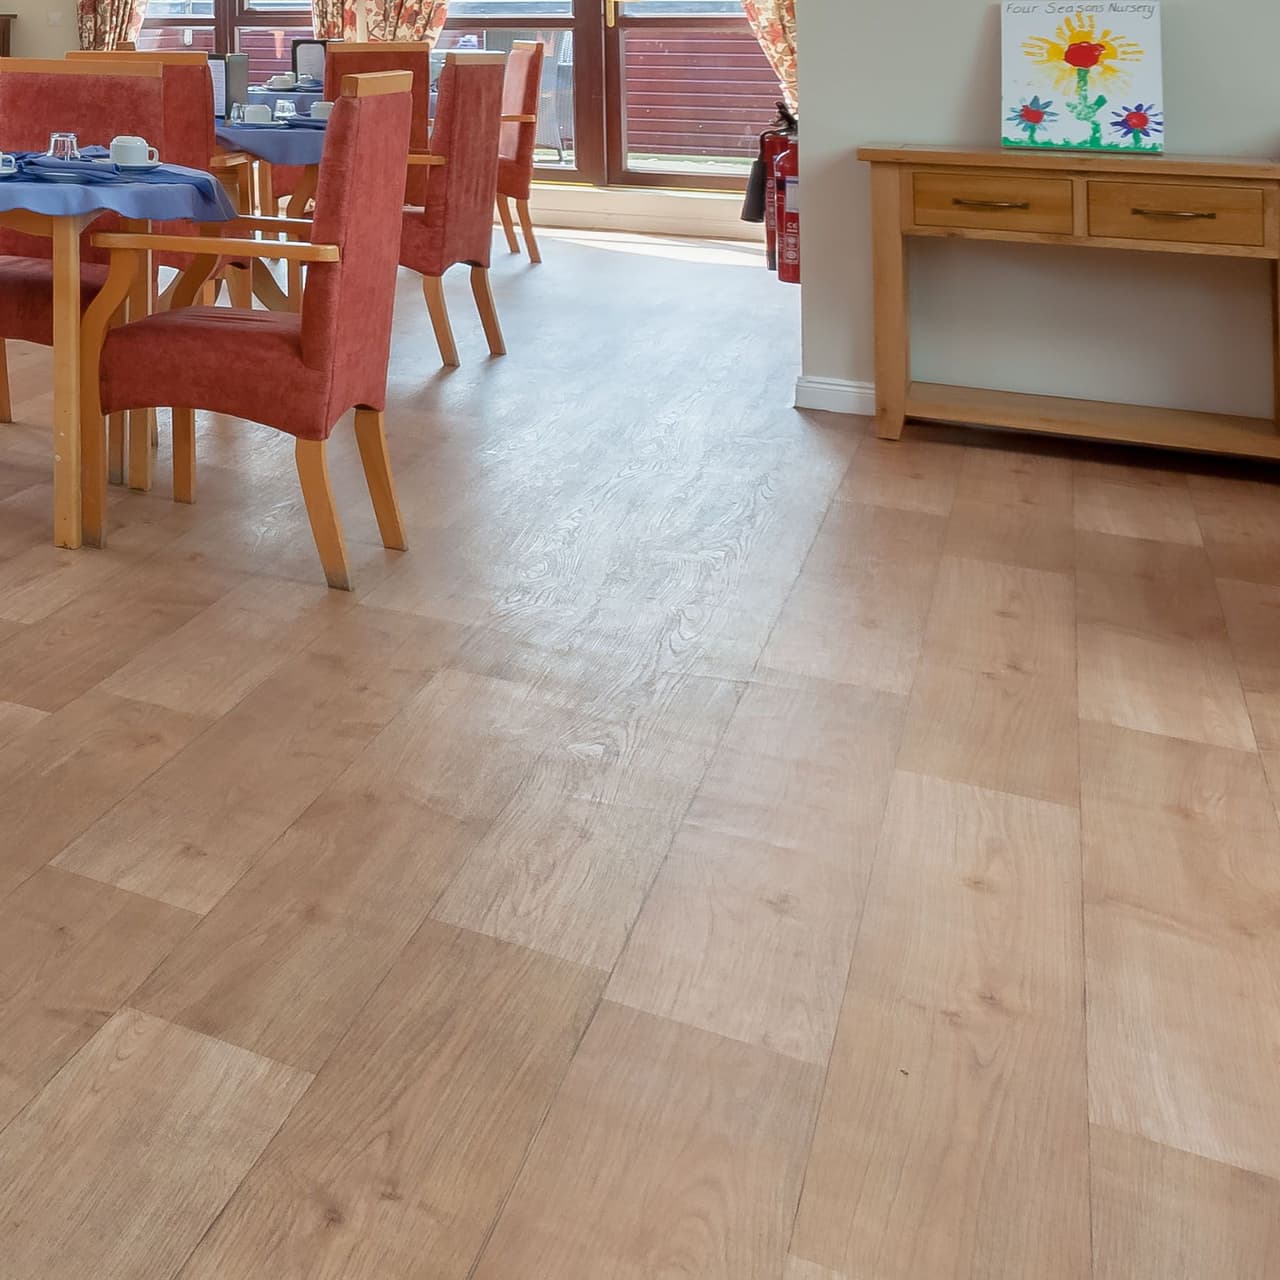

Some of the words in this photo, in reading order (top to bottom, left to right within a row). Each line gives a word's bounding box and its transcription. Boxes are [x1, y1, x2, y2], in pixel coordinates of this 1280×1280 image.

[1006, 2, 1039, 14] Four
[1045, 2, 1105, 14] Seasons
[1108, 2, 1155, 19] Nursery
